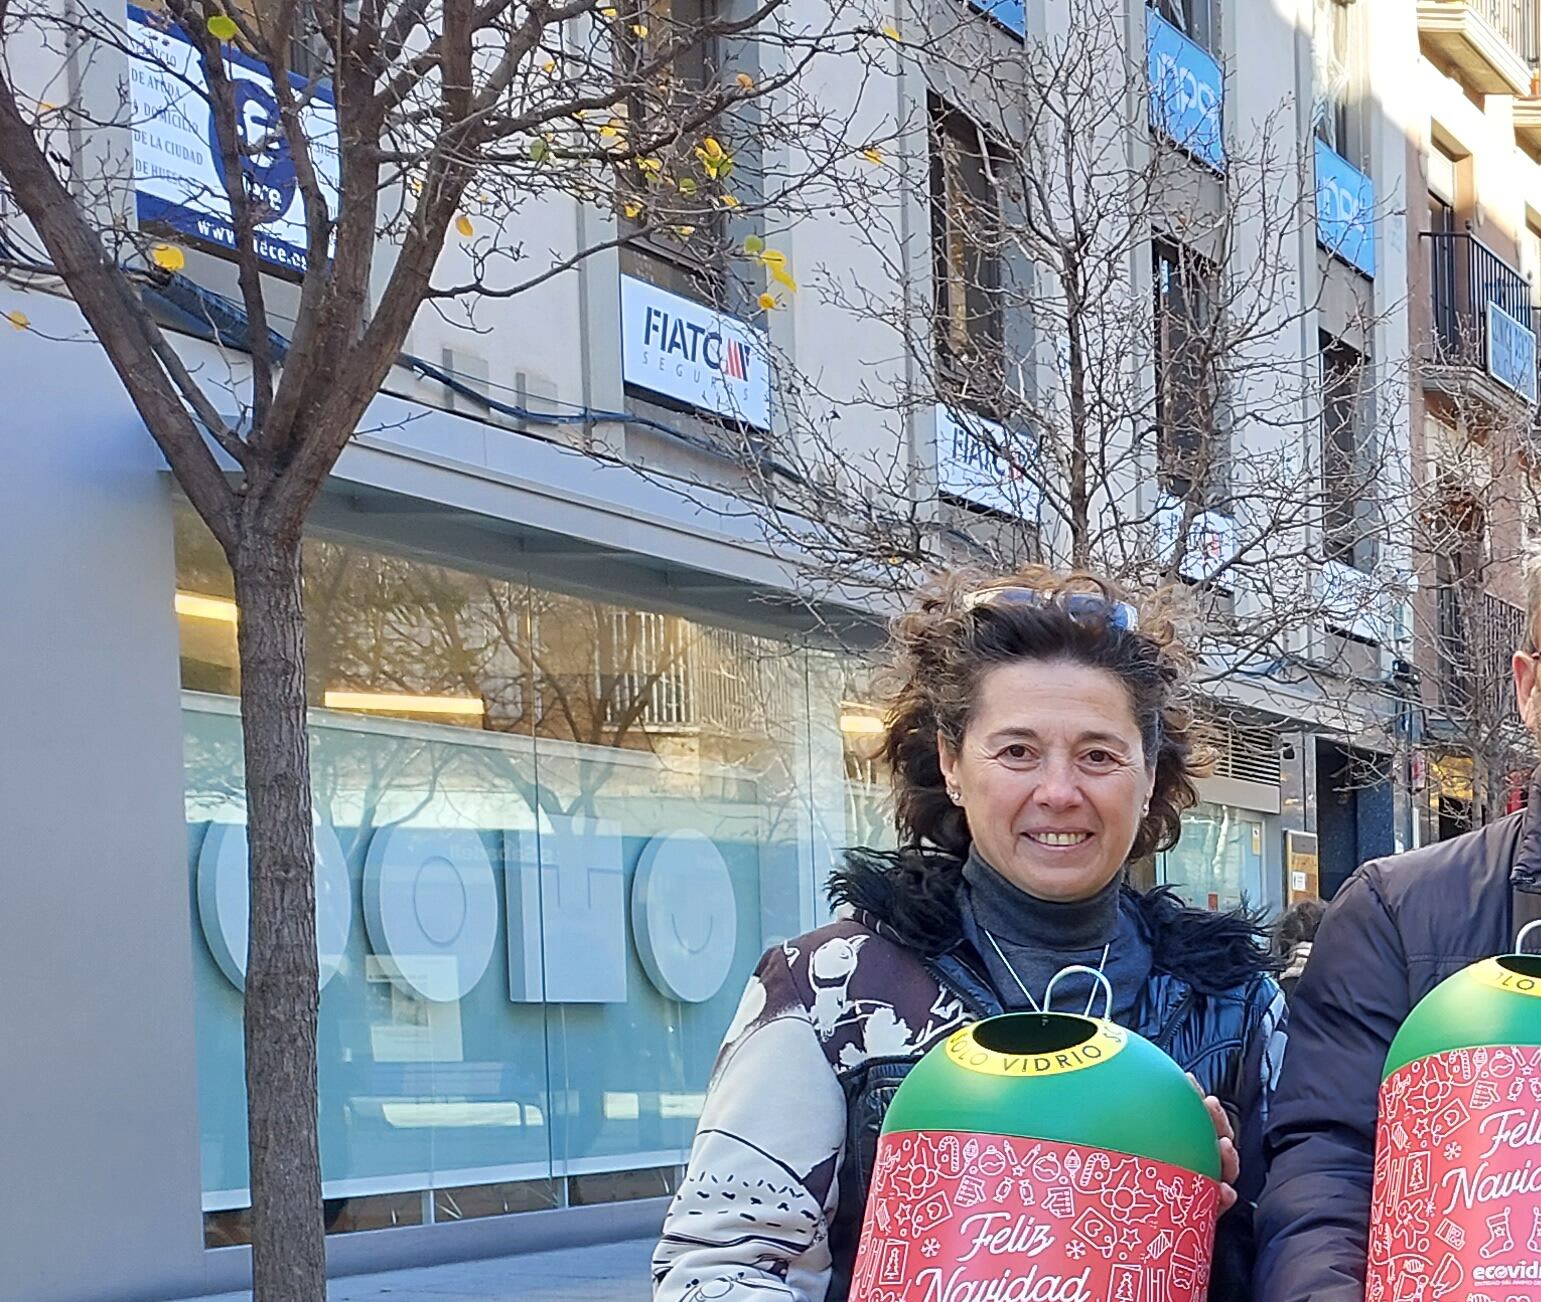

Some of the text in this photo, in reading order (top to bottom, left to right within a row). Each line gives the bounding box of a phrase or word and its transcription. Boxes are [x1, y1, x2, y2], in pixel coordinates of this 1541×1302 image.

[132, 67, 145, 86] DE
[134, 129, 204, 166] DE LA CIUDAD
[136, 158, 149, 175] DE
[1003, 1045, 1101, 1072] VIDRIO
[956, 1211, 1056, 1262] Feliz
